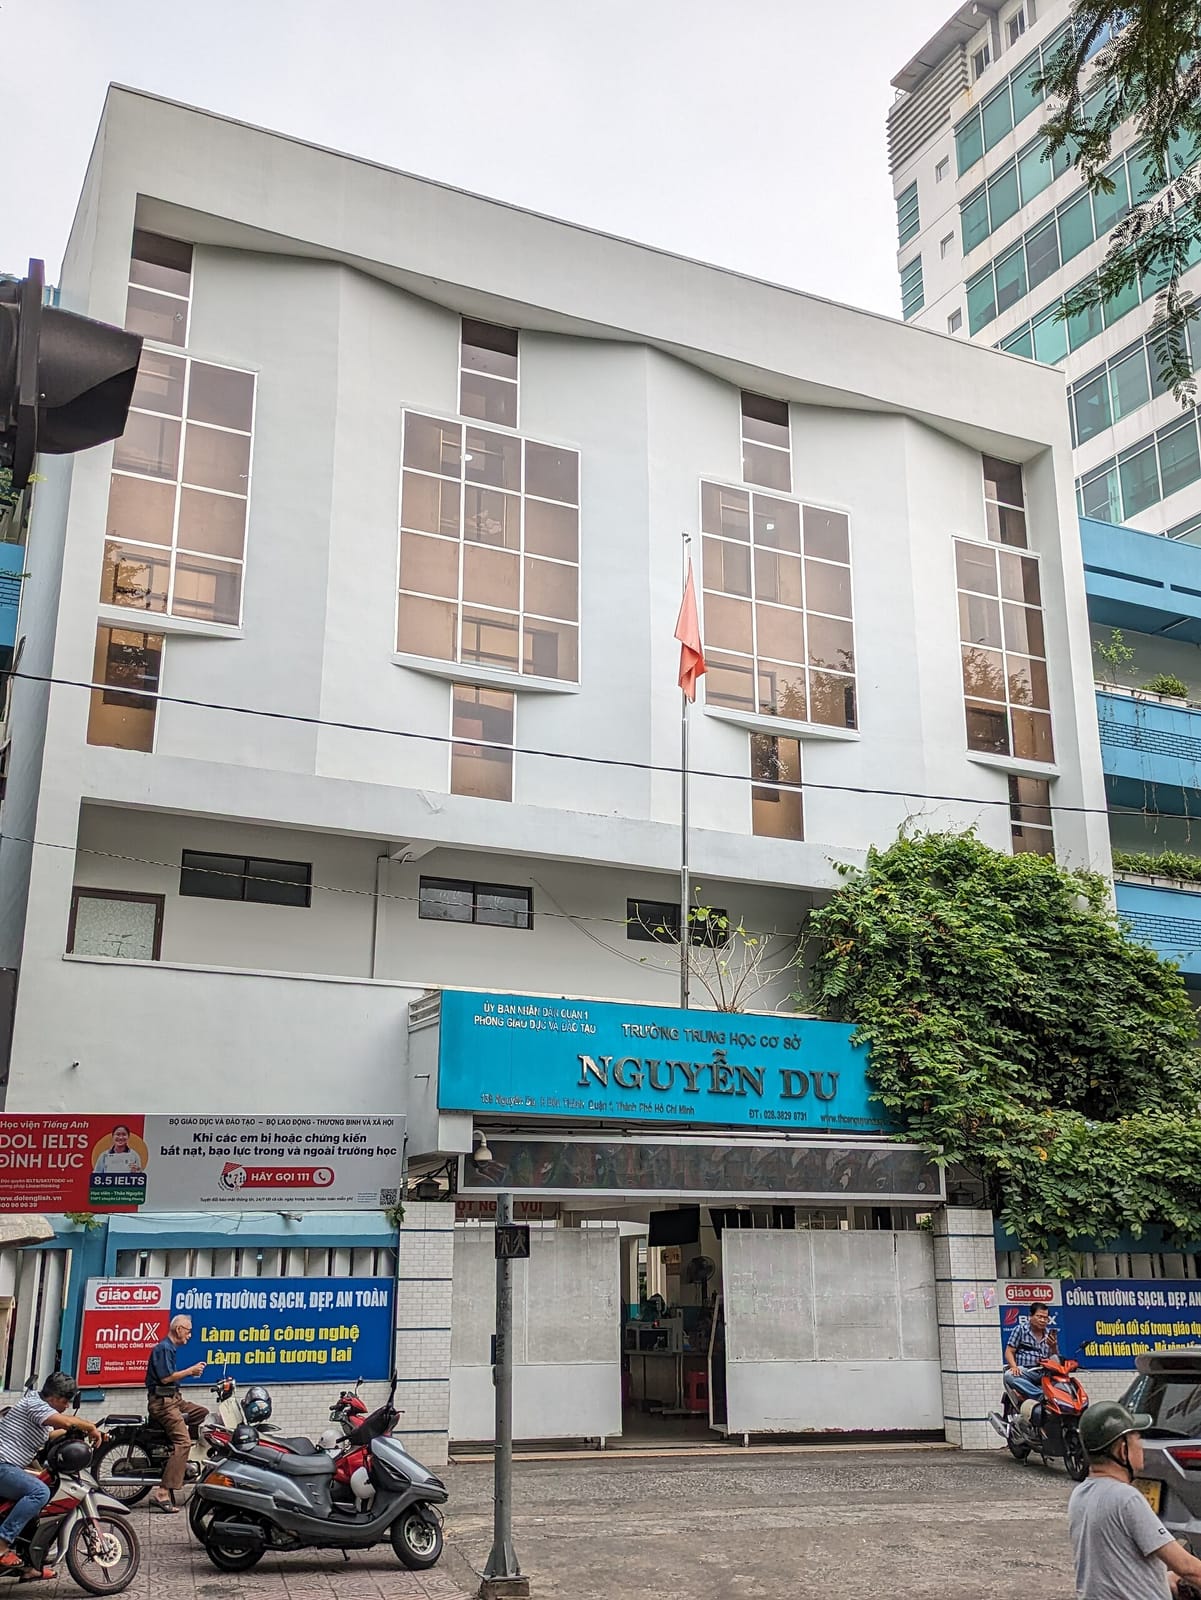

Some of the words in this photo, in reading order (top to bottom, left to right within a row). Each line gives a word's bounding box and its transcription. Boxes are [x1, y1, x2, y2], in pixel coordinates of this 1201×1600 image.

[497, 1004, 516, 1014] BAN
[584, 1011, 588, 1020] 1
[622, 1022, 680, 1040] TRƯỜNG
[684, 1028, 726, 1044] TRUNG
[729, 1032, 756, 1050] HỌC
[760, 1036, 779, 1048] CƠ
[783, 1033, 802, 1050] SỞ
[577, 1049, 765, 1097] NGUYỄN
[779, 1068, 839, 1100] DU
[0, 1120, 18, 1130] Học
[20, 1120, 40, 1130] viện
[42, 1120, 68, 1130] Tiếng
[70, 1120, 89, 1128] Anh
[168, 1118, 180, 1126] BỘ
[200, 1118, 214, 1126] DỤC
[242, 1118, 256, 1126] TẠO
[266, 1118, 276, 1126] BỘ
[292, 1118, 312, 1126] ĐỘNG
[317, 1118, 344, 1126] THƯƠNG
[362, 1118, 372, 1126] VÀ
[382, 1118, 394, 1126] HỘI
[0, 1134, 37, 1149] DOL
[42, 1134, 88, 1149] IELTS
[192, 1133, 213, 1142] Khi
[216, 1134, 238, 1142] các
[240, 1134, 258, 1142] em
[260, 1133, 272, 1144] bị
[274, 1133, 302, 1144] hoặc
[304, 1133, 340, 1144] chứng
[342, 1133, 367, 1143] kiến
[160, 1145, 180, 1156] bắt
[182, 1146, 206, 1157] nạt,
[208, 1146, 230, 1157] bạo
[234, 1146, 251, 1157] lực
[254, 1146, 284, 1157] trong
[287, 1146, 300, 1156] và
[303, 1146, 335, 1157] ngoài
[337, 1146, 374, 1157] trường
[376, 1146, 397, 1157] học
[48, 1152, 84, 1172] LỰC
[94, 1176, 112, 1186] 8.5
[115, 1176, 145, 1186] IELTS
[251, 1170, 274, 1182] HÃY
[275, 1172, 294, 1183] GỌI
[296, 1172, 310, 1182] 111
[521, 1200, 543, 1213] VUI
[98, 1287, 131, 1303] giáo
[133, 1288, 158, 1303] dục
[176, 1287, 214, 1309] CỔNG
[214, 1288, 267, 1309] TRƯỜNG
[270, 1291, 307, 1312] SẠCH,
[309, 1291, 334, 1312] ĐẸP,
[335, 1291, 353, 1308] AN
[355, 1288, 388, 1308] TOÀN
[1007, 1286, 1031, 1299] giáo
[1032, 1286, 1052, 1300] dục
[1066, 1286, 1094, 1306] CỔNG
[1095, 1288, 1136, 1306] TRƯỜNG
[1137, 1290, 1168, 1310] SẠCH,
[1168, 1291, 1188, 1310] ĐẸP,
[1188, 1292, 1201, 1306] AN
[96, 1322, 160, 1342] mindX
[201, 1327, 236, 1342] Làm
[239, 1324, 270, 1342] chủ
[274, 1326, 316, 1342] công
[318, 1324, 360, 1343] nghệ
[1096, 1318, 1126, 1336] Chuyển
[1140, 1320, 1150, 1335] số
[1150, 1322, 1172, 1336] trong
[1172, 1320, 1190, 1336] giáo
[1190, 1322, 1201, 1338] dụ
[206, 1349, 241, 1365] Làm
[244, 1347, 276, 1364] chủ
[279, 1349, 328, 1364] tương
[331, 1346, 352, 1362] lai
[1084, 1341, 1099, 1356] Kết
[1100, 1340, 1113, 1356] nối
[1113, 1340, 1130, 1356] kiến
